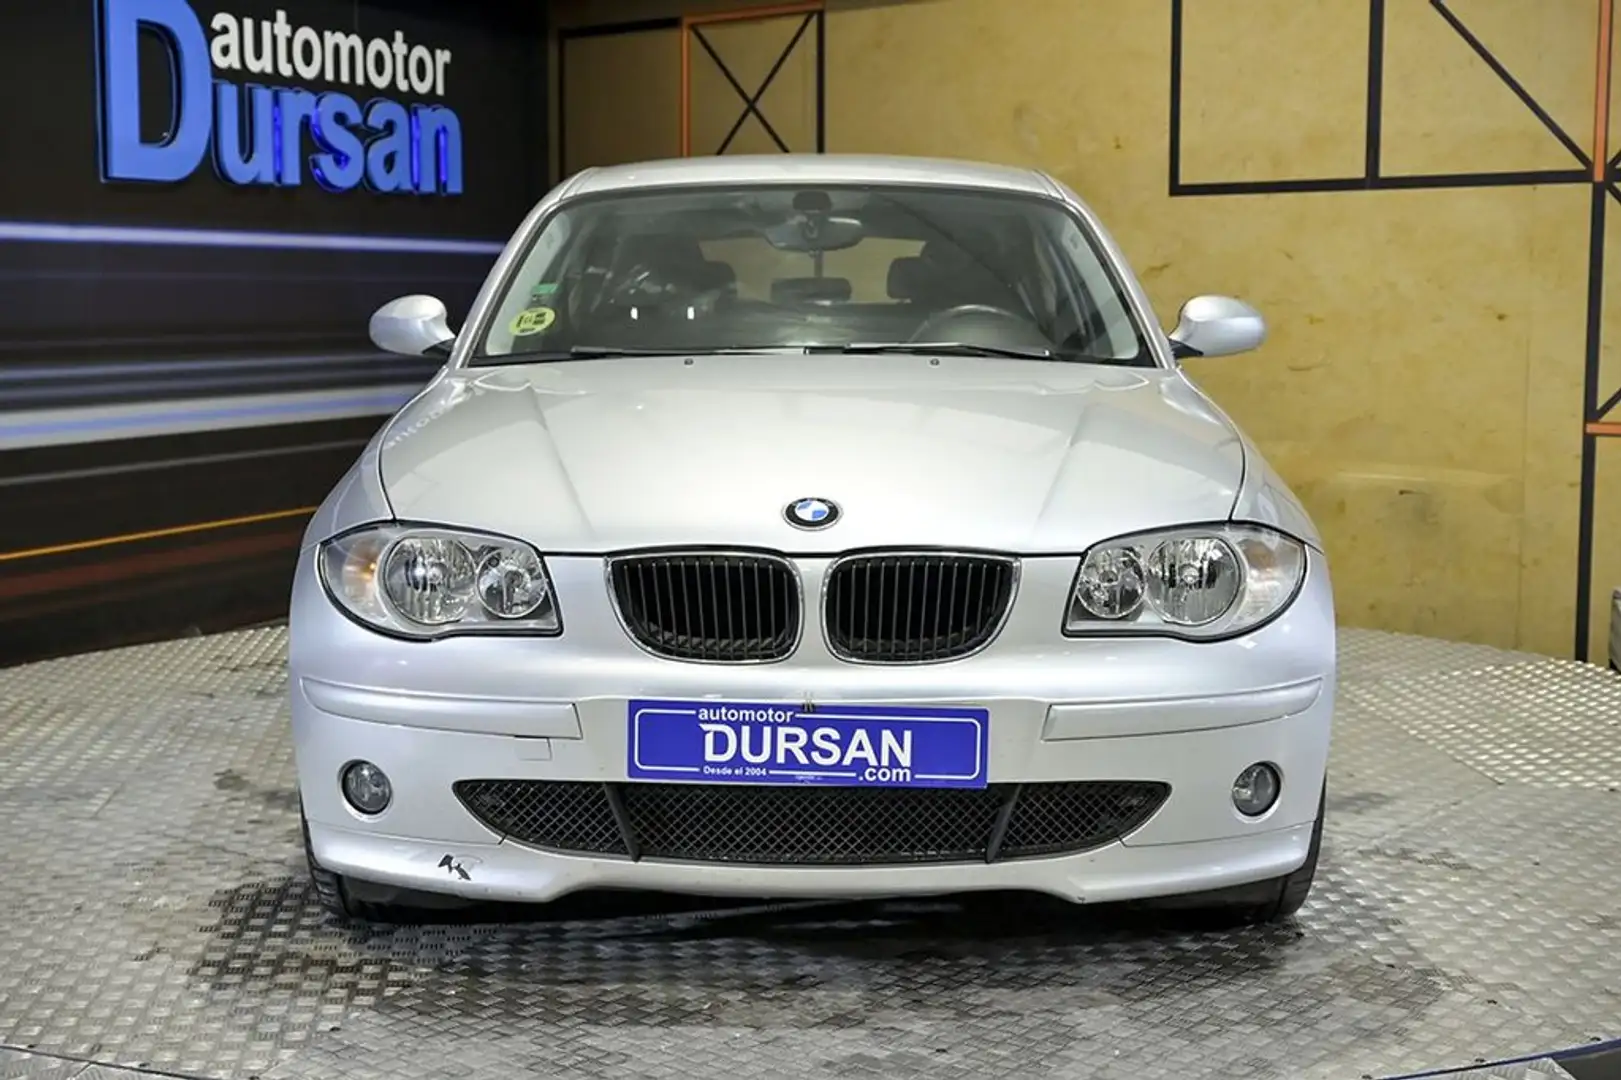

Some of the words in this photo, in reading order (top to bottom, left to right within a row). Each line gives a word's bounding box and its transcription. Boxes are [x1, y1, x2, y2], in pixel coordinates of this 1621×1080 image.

[210, 10, 451, 96] automotor
[96, 0, 462, 195] Dursan
[698, 706, 794, 723] automotor
[699, 723, 912, 767] DURSAN
[703, 765, 732, 776] Desde
[734, 766, 743, 776] el
[744, 766, 767, 776] 2004
[858, 766, 911, 782] .com
